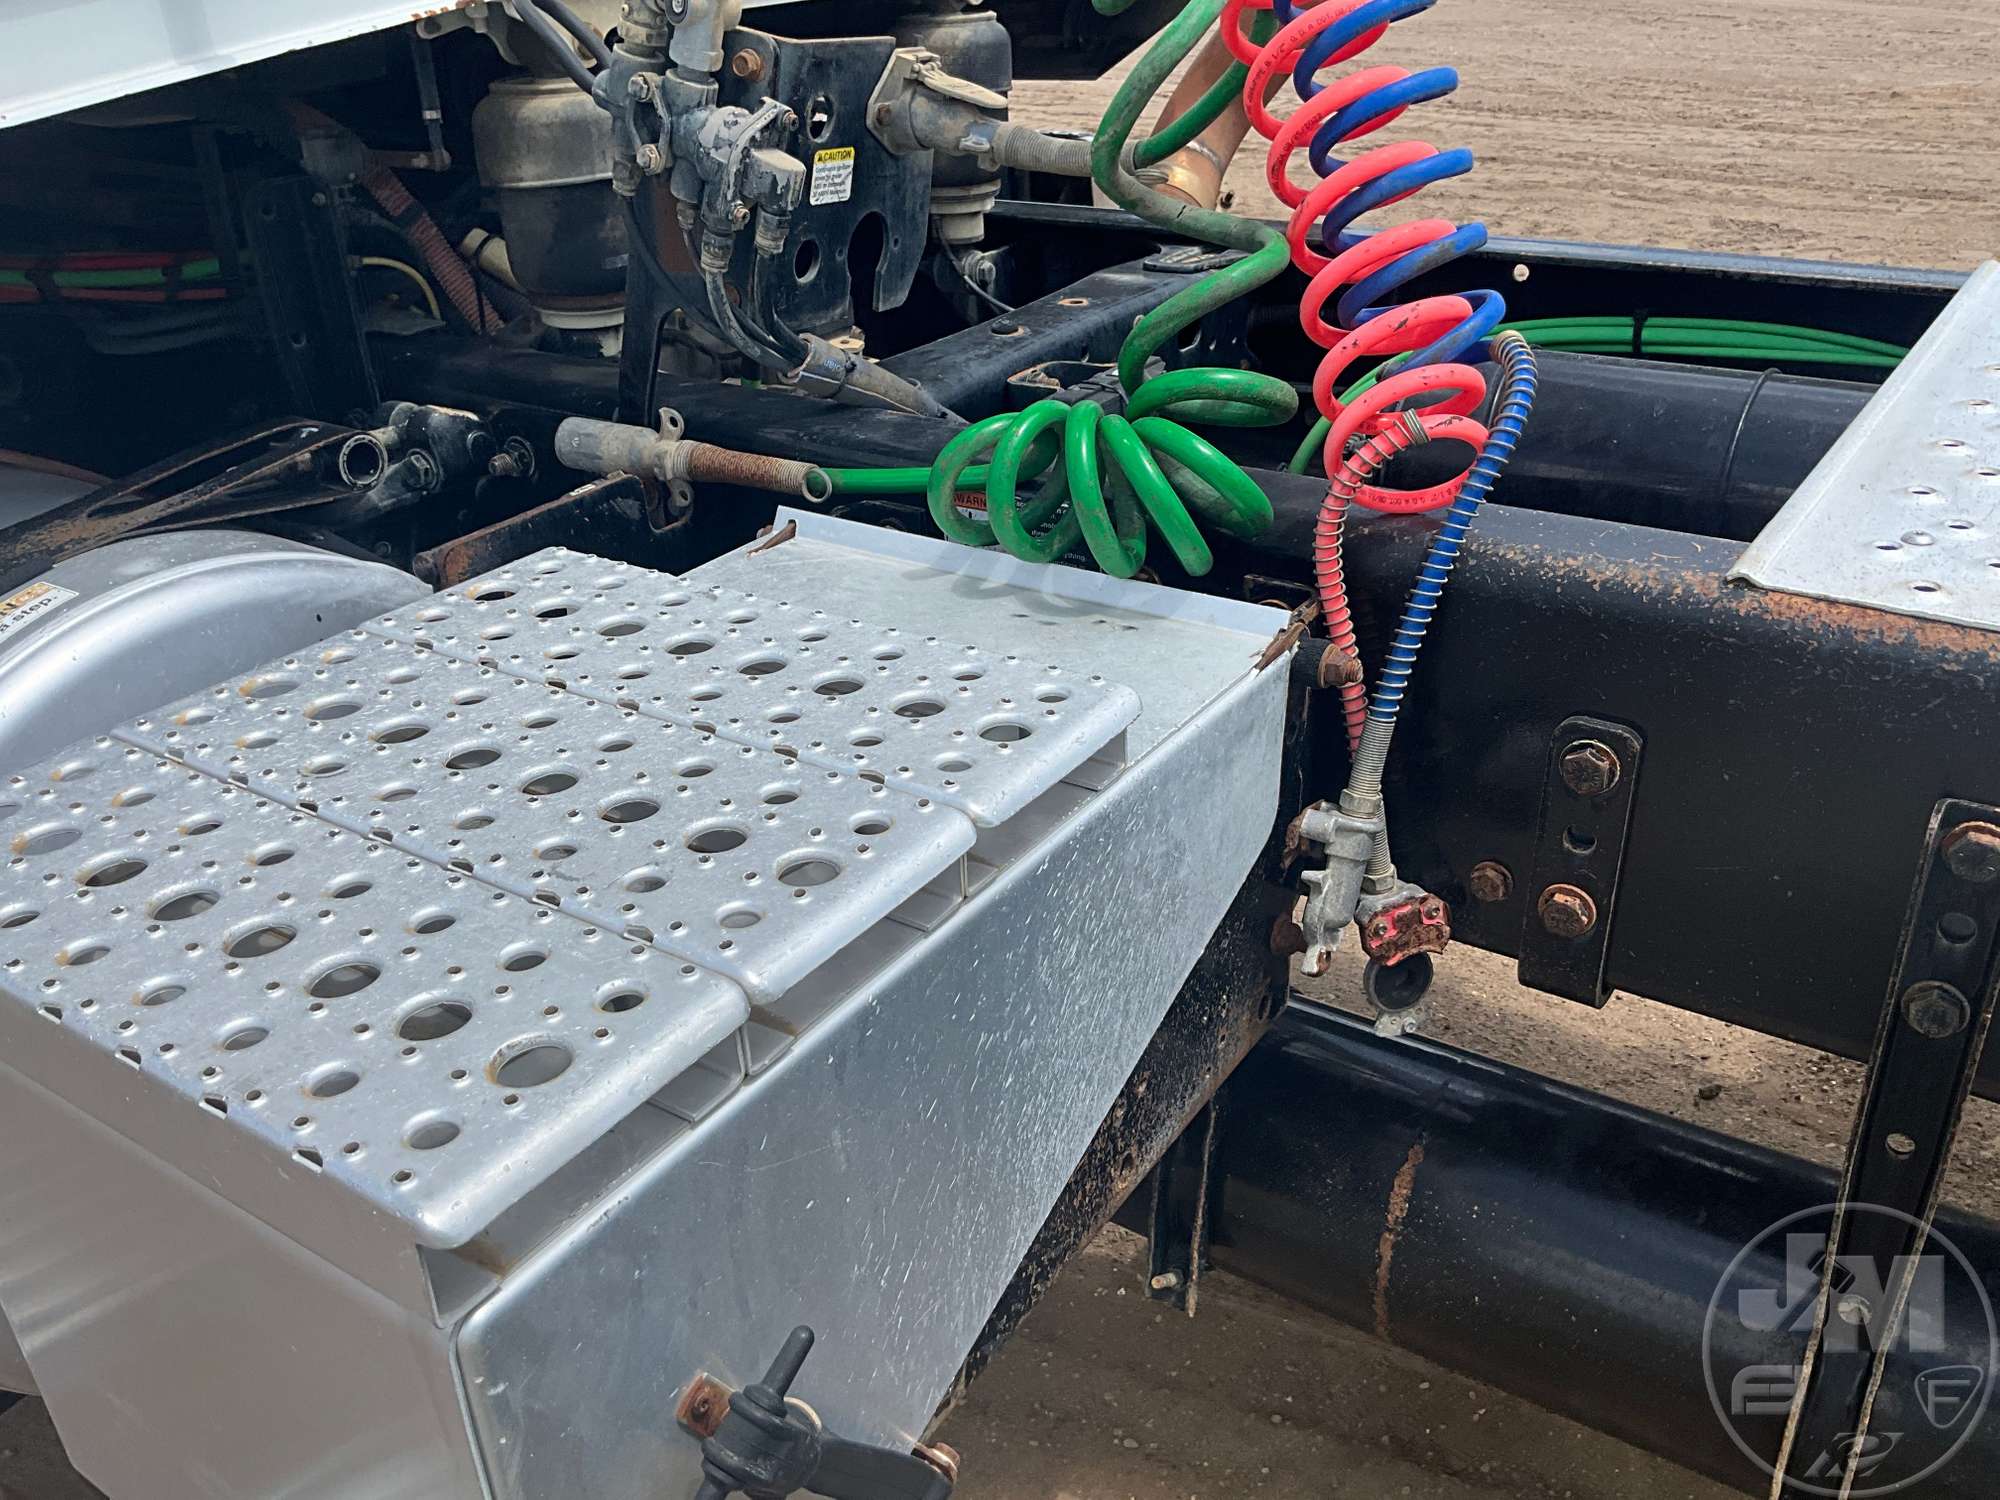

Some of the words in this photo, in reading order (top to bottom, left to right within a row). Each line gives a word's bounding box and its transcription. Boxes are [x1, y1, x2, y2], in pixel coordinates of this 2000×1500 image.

[824, 150, 852, 161] CAUTION
[953, 494, 986, 509] WARN
[12, 596, 58, 621] step.
